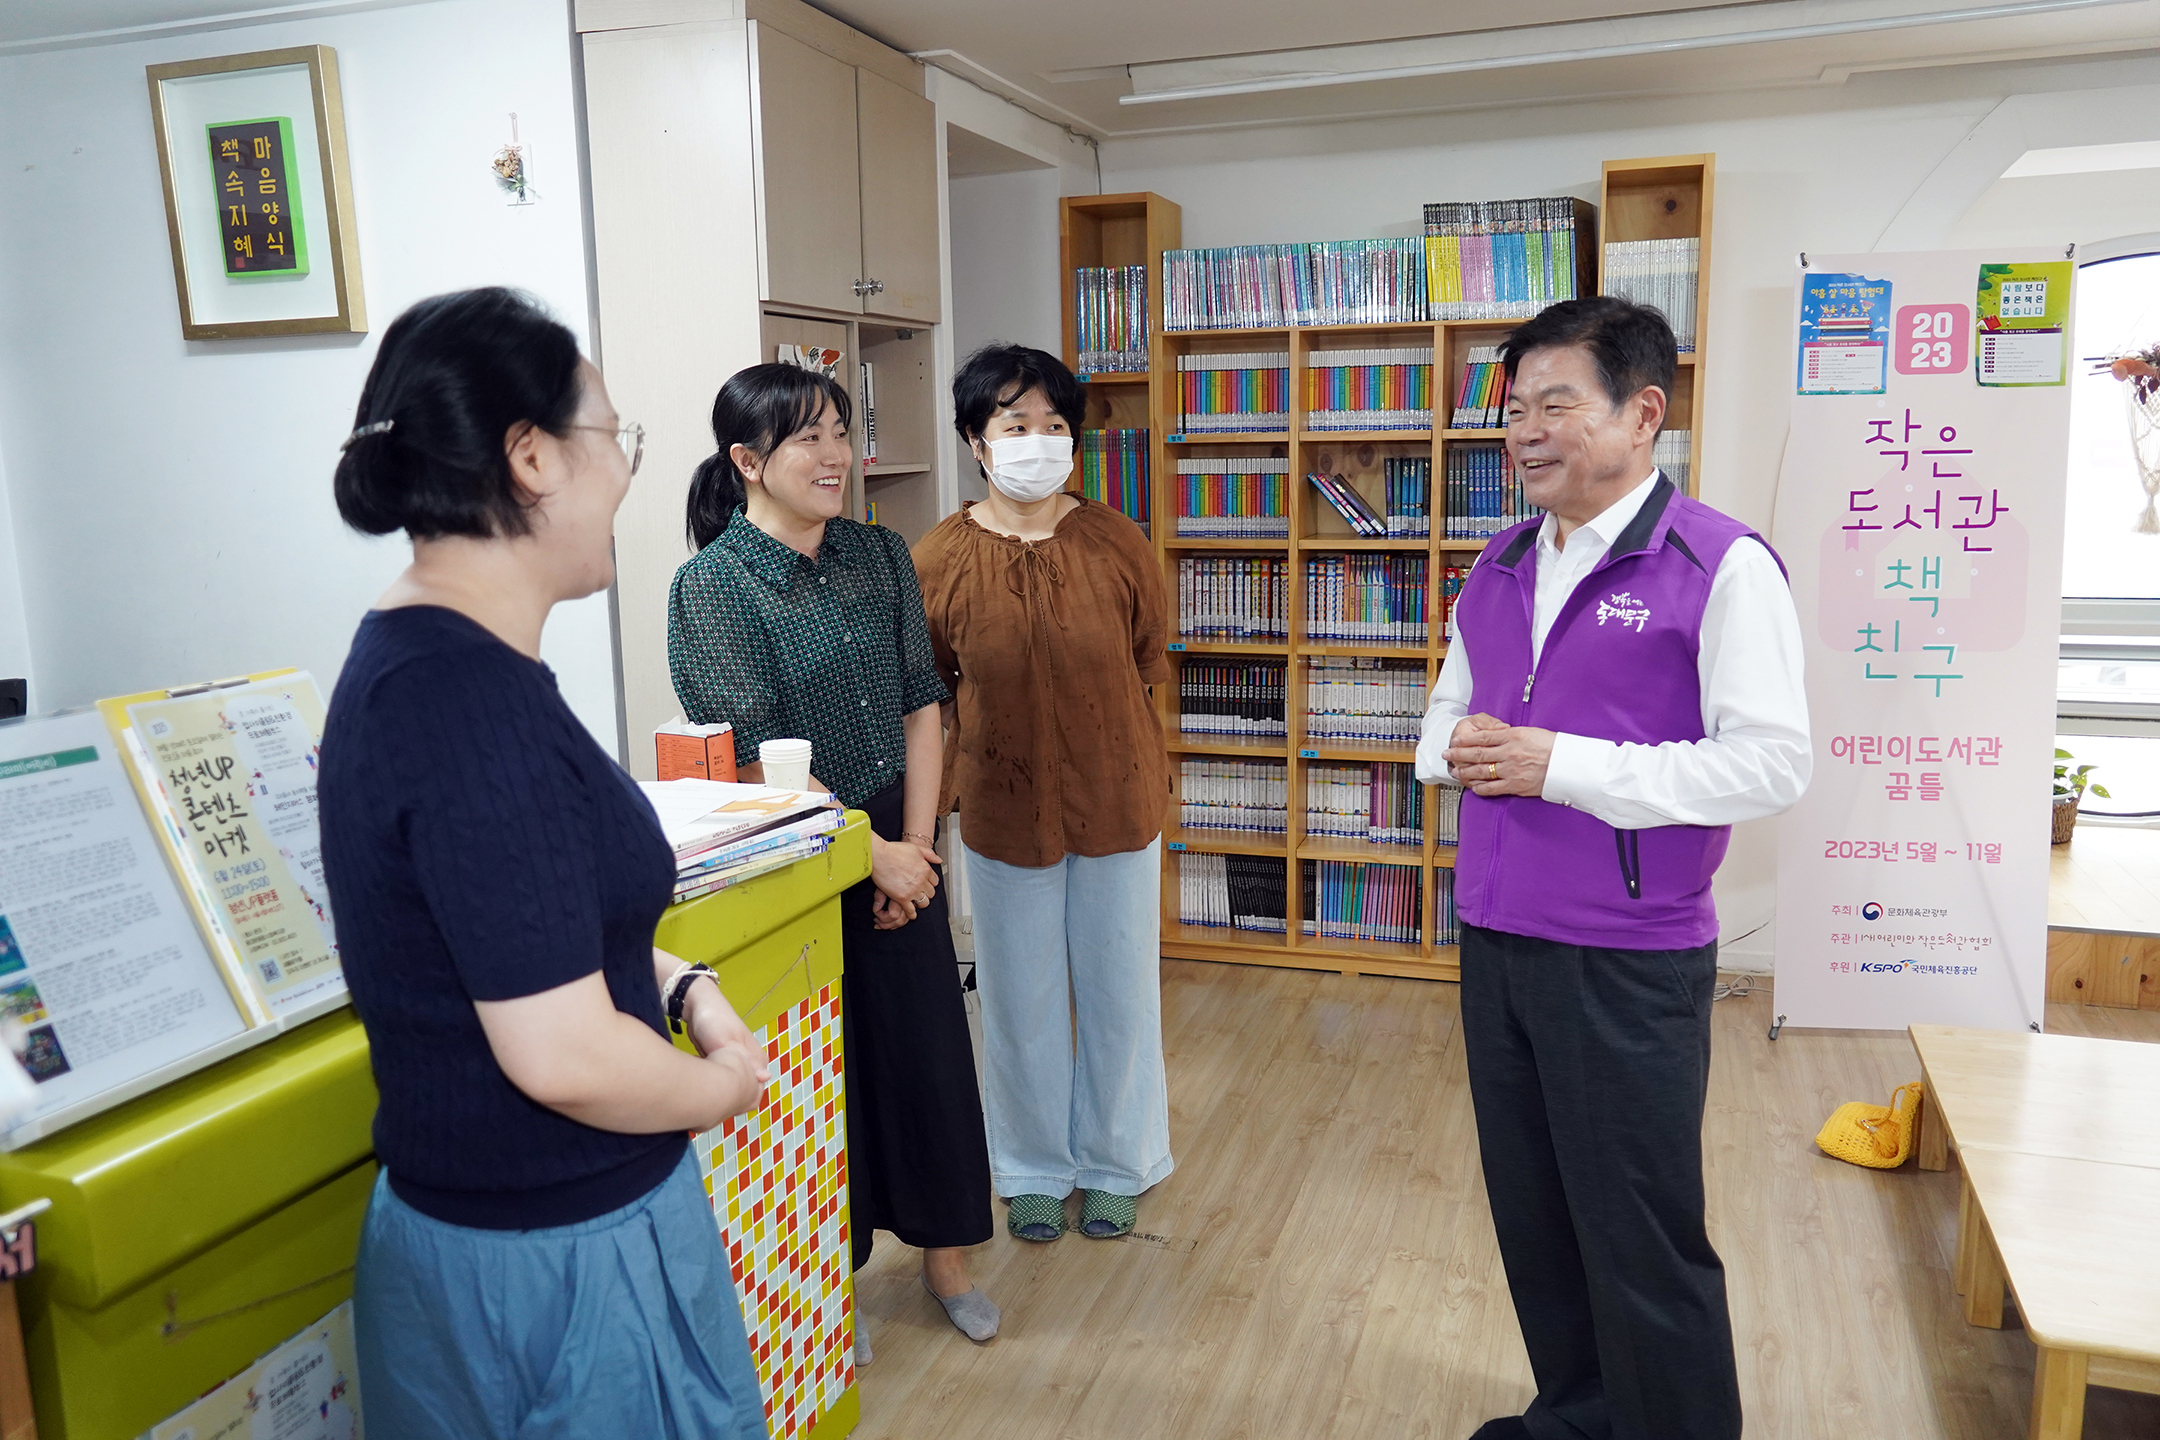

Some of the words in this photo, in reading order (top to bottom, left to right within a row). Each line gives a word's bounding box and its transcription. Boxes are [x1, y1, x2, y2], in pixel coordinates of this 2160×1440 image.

[1911, 312, 1954, 339] 20
[1910, 341, 1953, 369] 23
[1865, 408, 1974, 478] 작은
[1841, 488, 2010, 552] 도서관
[1883, 555, 1942, 618] 책
[1596, 599, 1651, 633] 동대문구
[1853, 619, 1964, 698] 친구
[1830, 735, 2003, 766] 어린이도서관
[169, 755, 234, 794] 청년UP
[1885, 772, 1945, 801] 꿈틀
[182, 792, 248, 832] 콘텐츠
[204, 823, 250, 858] 마켓
[1824, 840, 1900, 862] 2023년
[1906, 841, 1938, 863] 5월
[1966, 843, 2002, 864] 11월
[1831, 905, 1851, 916] 주최
[1887, 907, 1948, 918] 문화체육관광부
[1830, 933, 1851, 945] 주관
[1829, 961, 1850, 973] 후원
[1860, 962, 1903, 974] KSPO
[1911, 964, 1978, 976] 국민체육진흥공단
